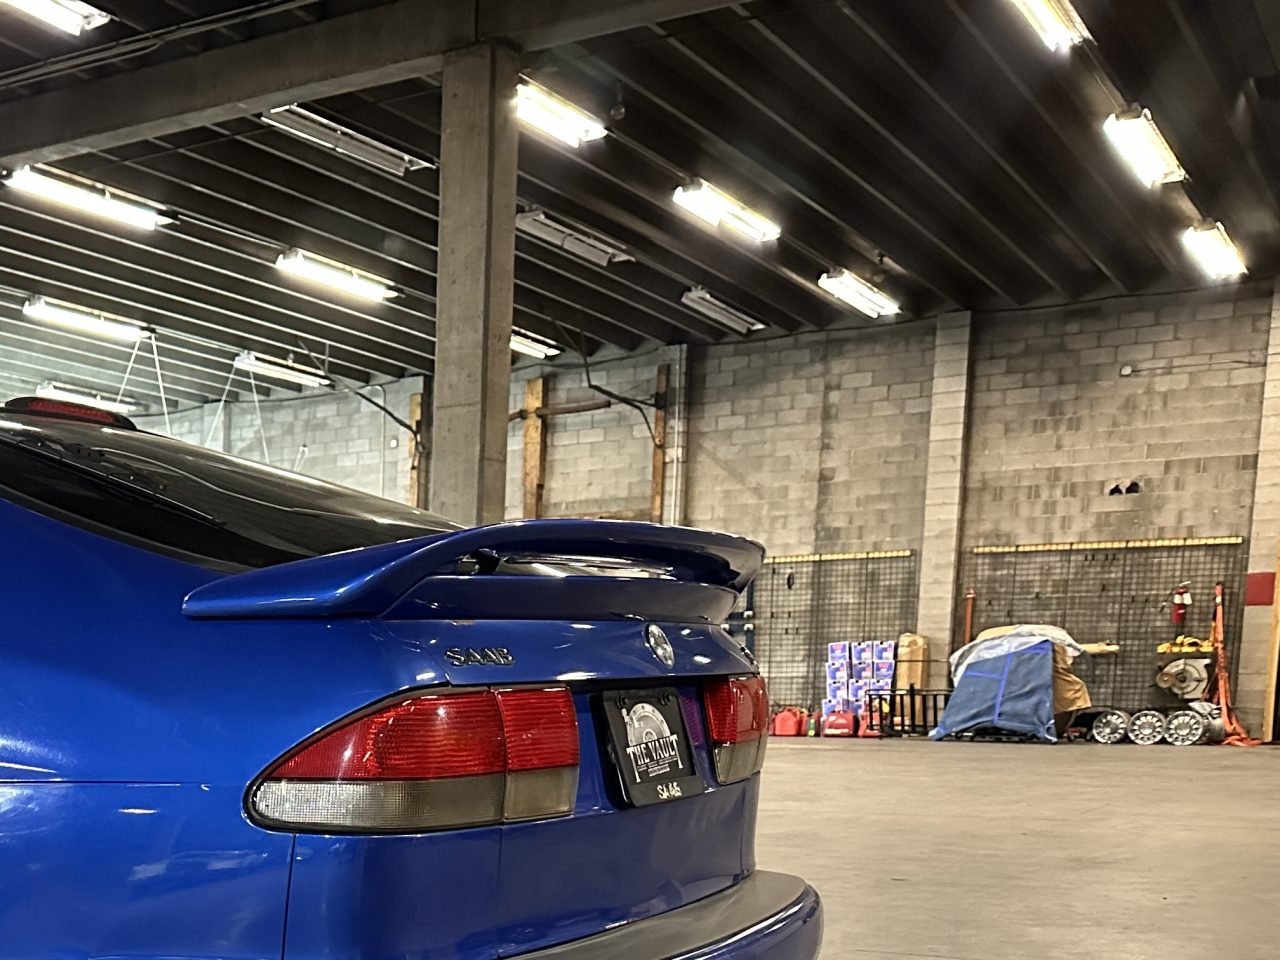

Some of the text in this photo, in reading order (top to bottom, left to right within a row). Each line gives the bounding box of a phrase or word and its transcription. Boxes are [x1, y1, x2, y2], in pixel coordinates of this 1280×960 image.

[445, 647, 513, 667] SAAB
[626, 743, 650, 783] THE
[648, 734, 683, 769] VAULT
